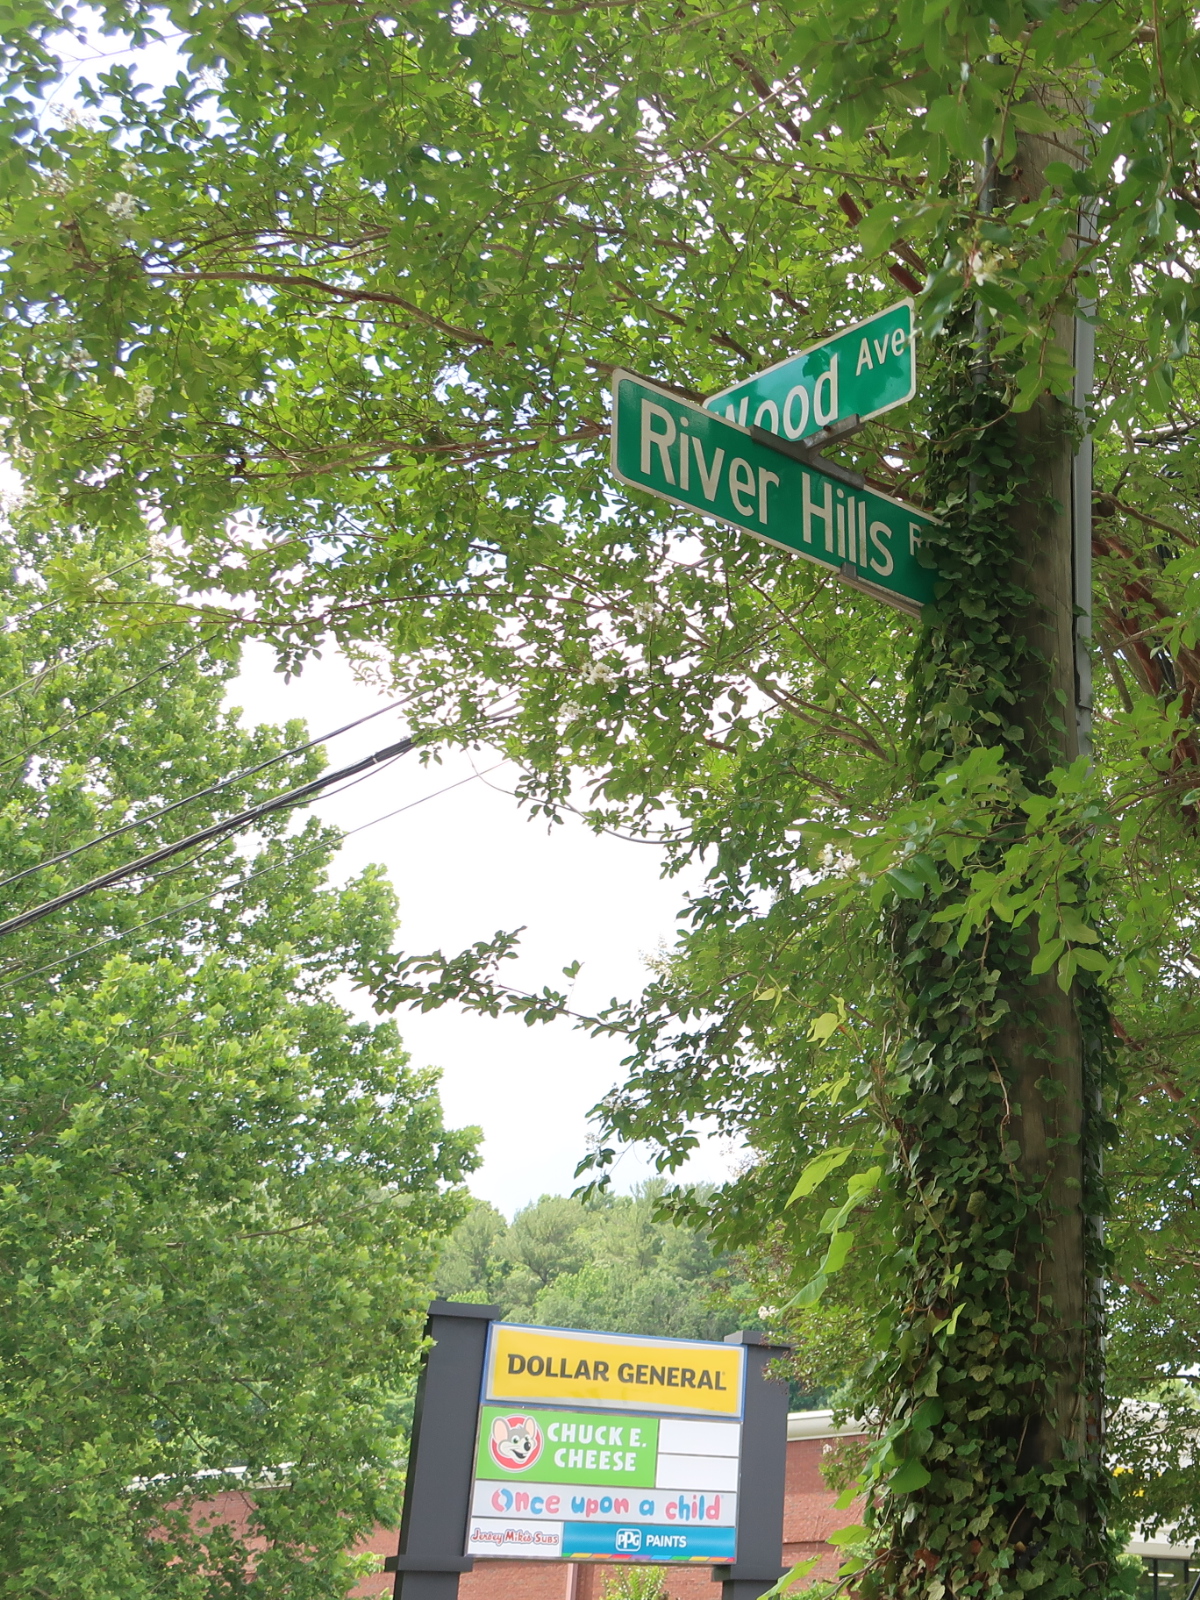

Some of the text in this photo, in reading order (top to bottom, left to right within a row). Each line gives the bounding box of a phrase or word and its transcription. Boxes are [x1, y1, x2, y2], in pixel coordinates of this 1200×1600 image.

[855, 328, 904, 376] Ave
[640, 398, 930, 577] River Hills R
[507, 1354, 727, 1390] DOLLAR GENERAL
[547, 1422, 647, 1447] CHUCK E.
[554, 1448, 637, 1471] CHEESE
[491, 1488, 721, 1521] Once upon a child
[471, 1528, 503, 1545] Jersey
[646, 1535, 687, 1548] PAINTS
